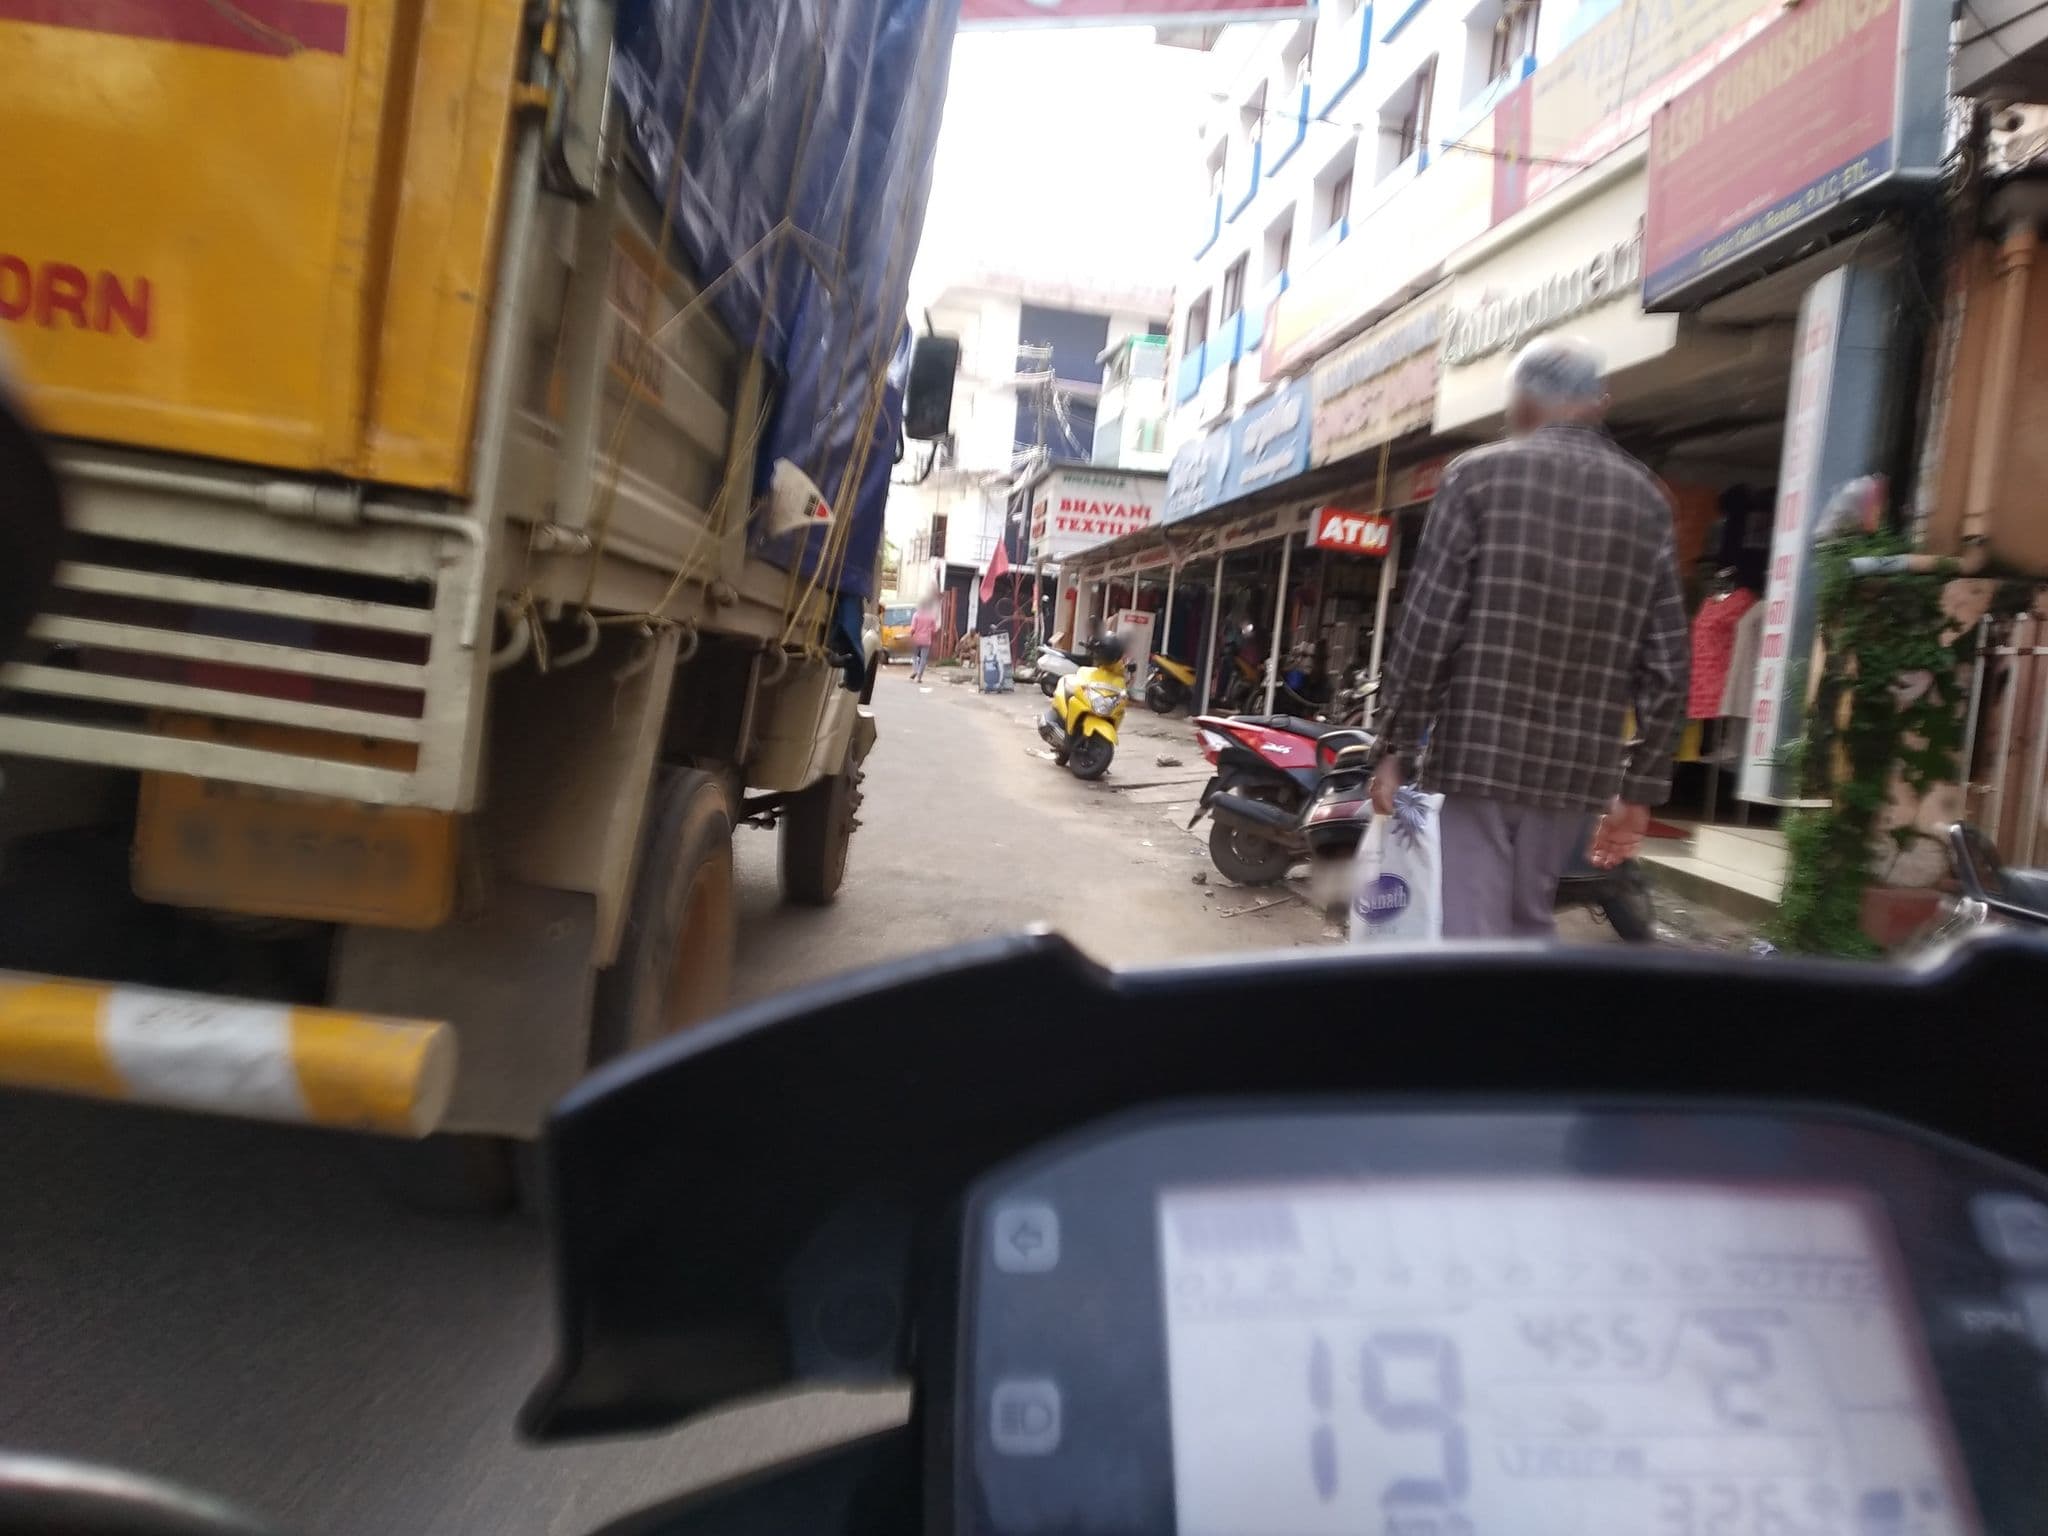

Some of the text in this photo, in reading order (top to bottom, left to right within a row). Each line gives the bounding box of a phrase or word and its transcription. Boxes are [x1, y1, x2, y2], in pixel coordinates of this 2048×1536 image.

[1711, 0, 1892, 132] FURNISHING
[1060, 498, 1151, 519] BHAVANI
[1056, 515, 1148, 536] TEXTILE
[1319, 516, 1389, 547] ATM
